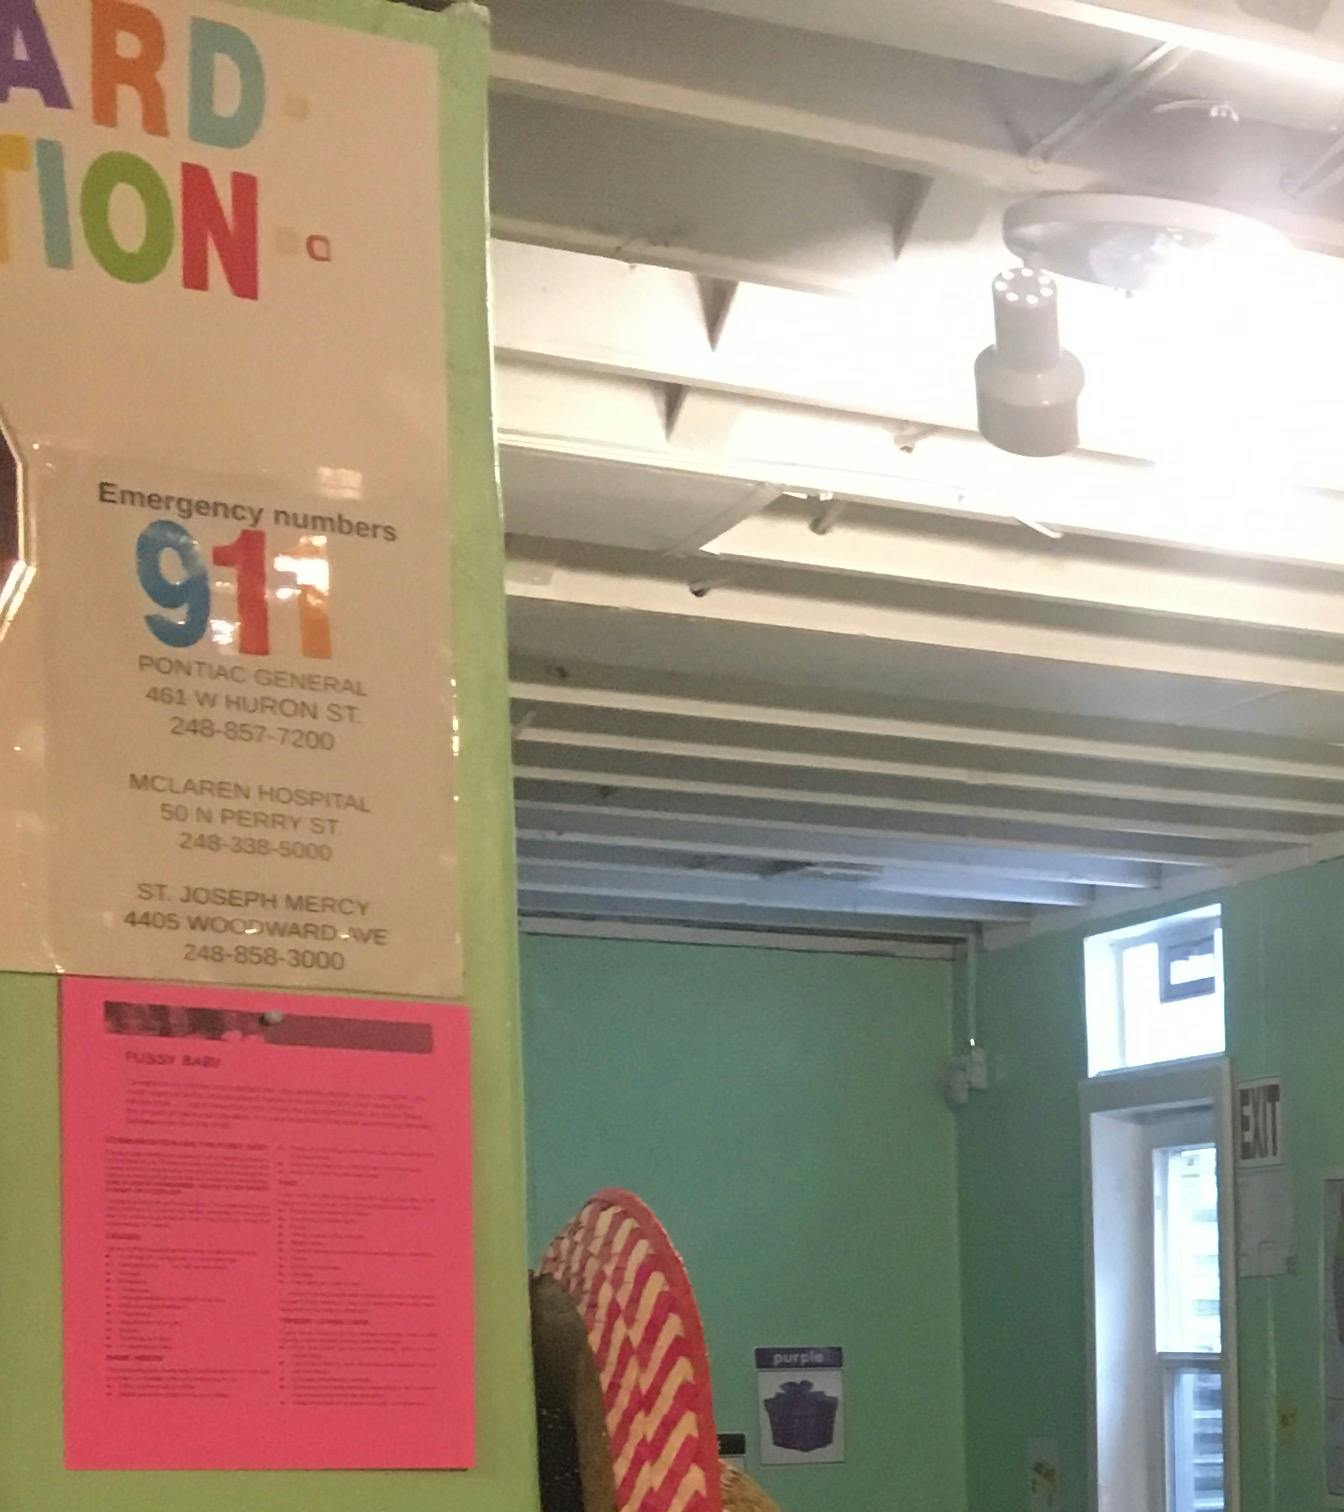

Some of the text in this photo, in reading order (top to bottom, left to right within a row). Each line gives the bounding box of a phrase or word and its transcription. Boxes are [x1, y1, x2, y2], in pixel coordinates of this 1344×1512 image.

[0, 0, 265, 149] ARD
[98, 481, 398, 542] Emergency numbers
[135, 519, 332, 660] 911
[138, 654, 368, 697] PONTIAC GENERAL
[145, 685, 186, 706] 461
[194, 690, 217, 709] W
[226, 694, 318, 720] HURON
[169, 715, 336, 751] 248-857-7200
[129, 773, 372, 814] MCLAREN HOSPITAL
[160, 802, 188, 823] 50
[196, 807, 212, 825] N
[220, 808, 301, 832] PERRY
[178, 832, 333, 862] 248-338-5000
[179, 885, 277, 910] JOSEPH
[285, 893, 370, 917] MERCY
[123, 910, 389, 947] 4405 WOODWARD AVE
[183, 943, 345, 971] 248-858-3000
[1239, 1083, 1280, 1161] EXIT
[772, 1350, 824, 1366] purple
